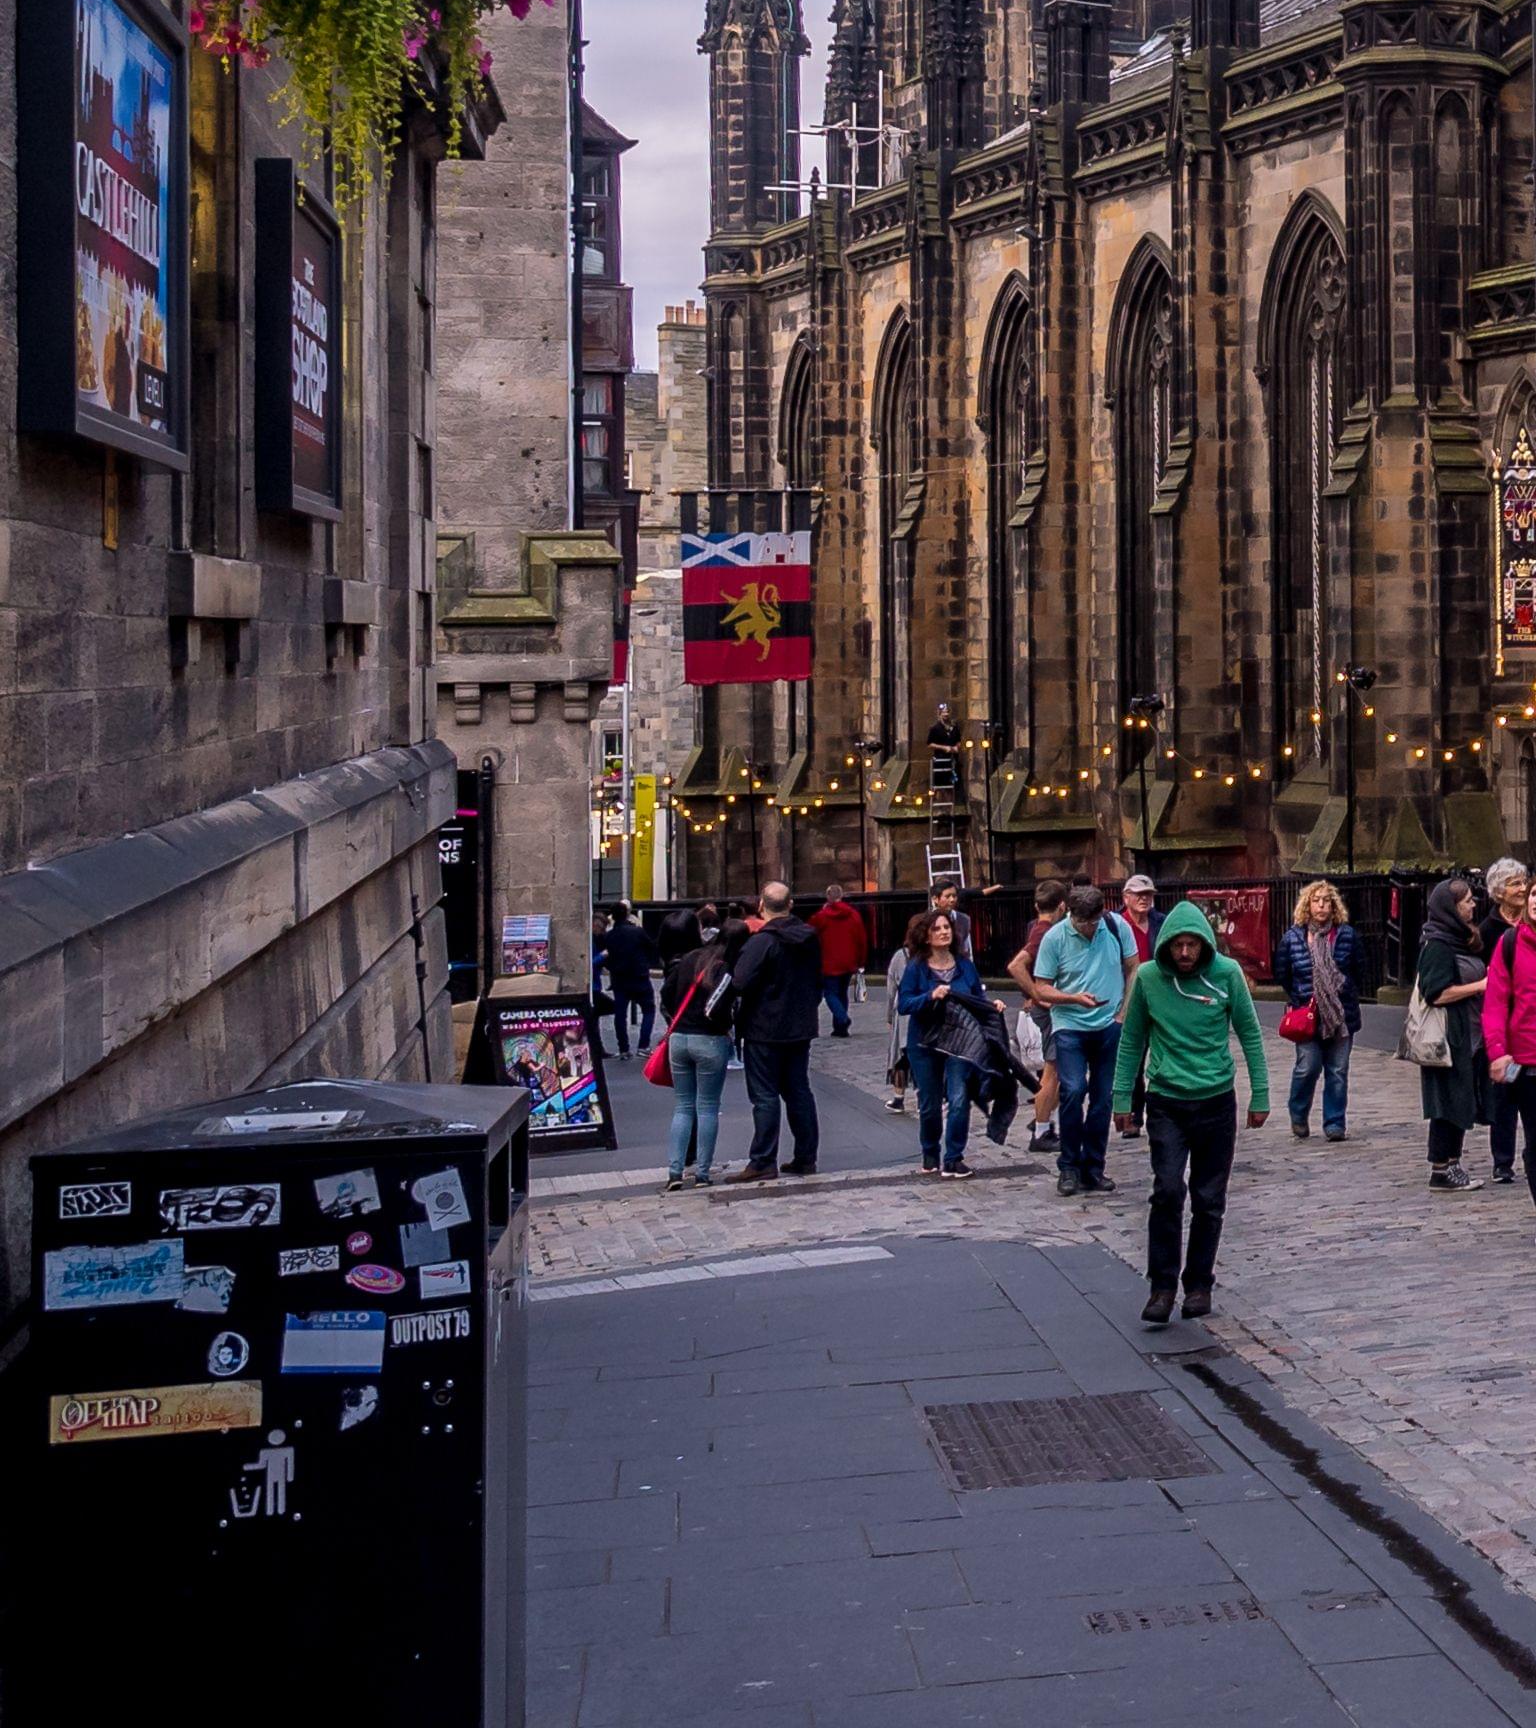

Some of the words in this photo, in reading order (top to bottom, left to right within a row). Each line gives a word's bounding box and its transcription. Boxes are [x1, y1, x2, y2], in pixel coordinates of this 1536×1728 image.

[77, 141, 160, 269] CASTLEHILL
[292, 324, 327, 418] SHOP
[439, 839, 462, 850] OF
[500, 1010, 537, 1020] CAMERA
[537, 1008, 579, 1018] OBSCURA
[393, 1313, 453, 1345] OUTPOST
[453, 1309, 470, 1338] 79
